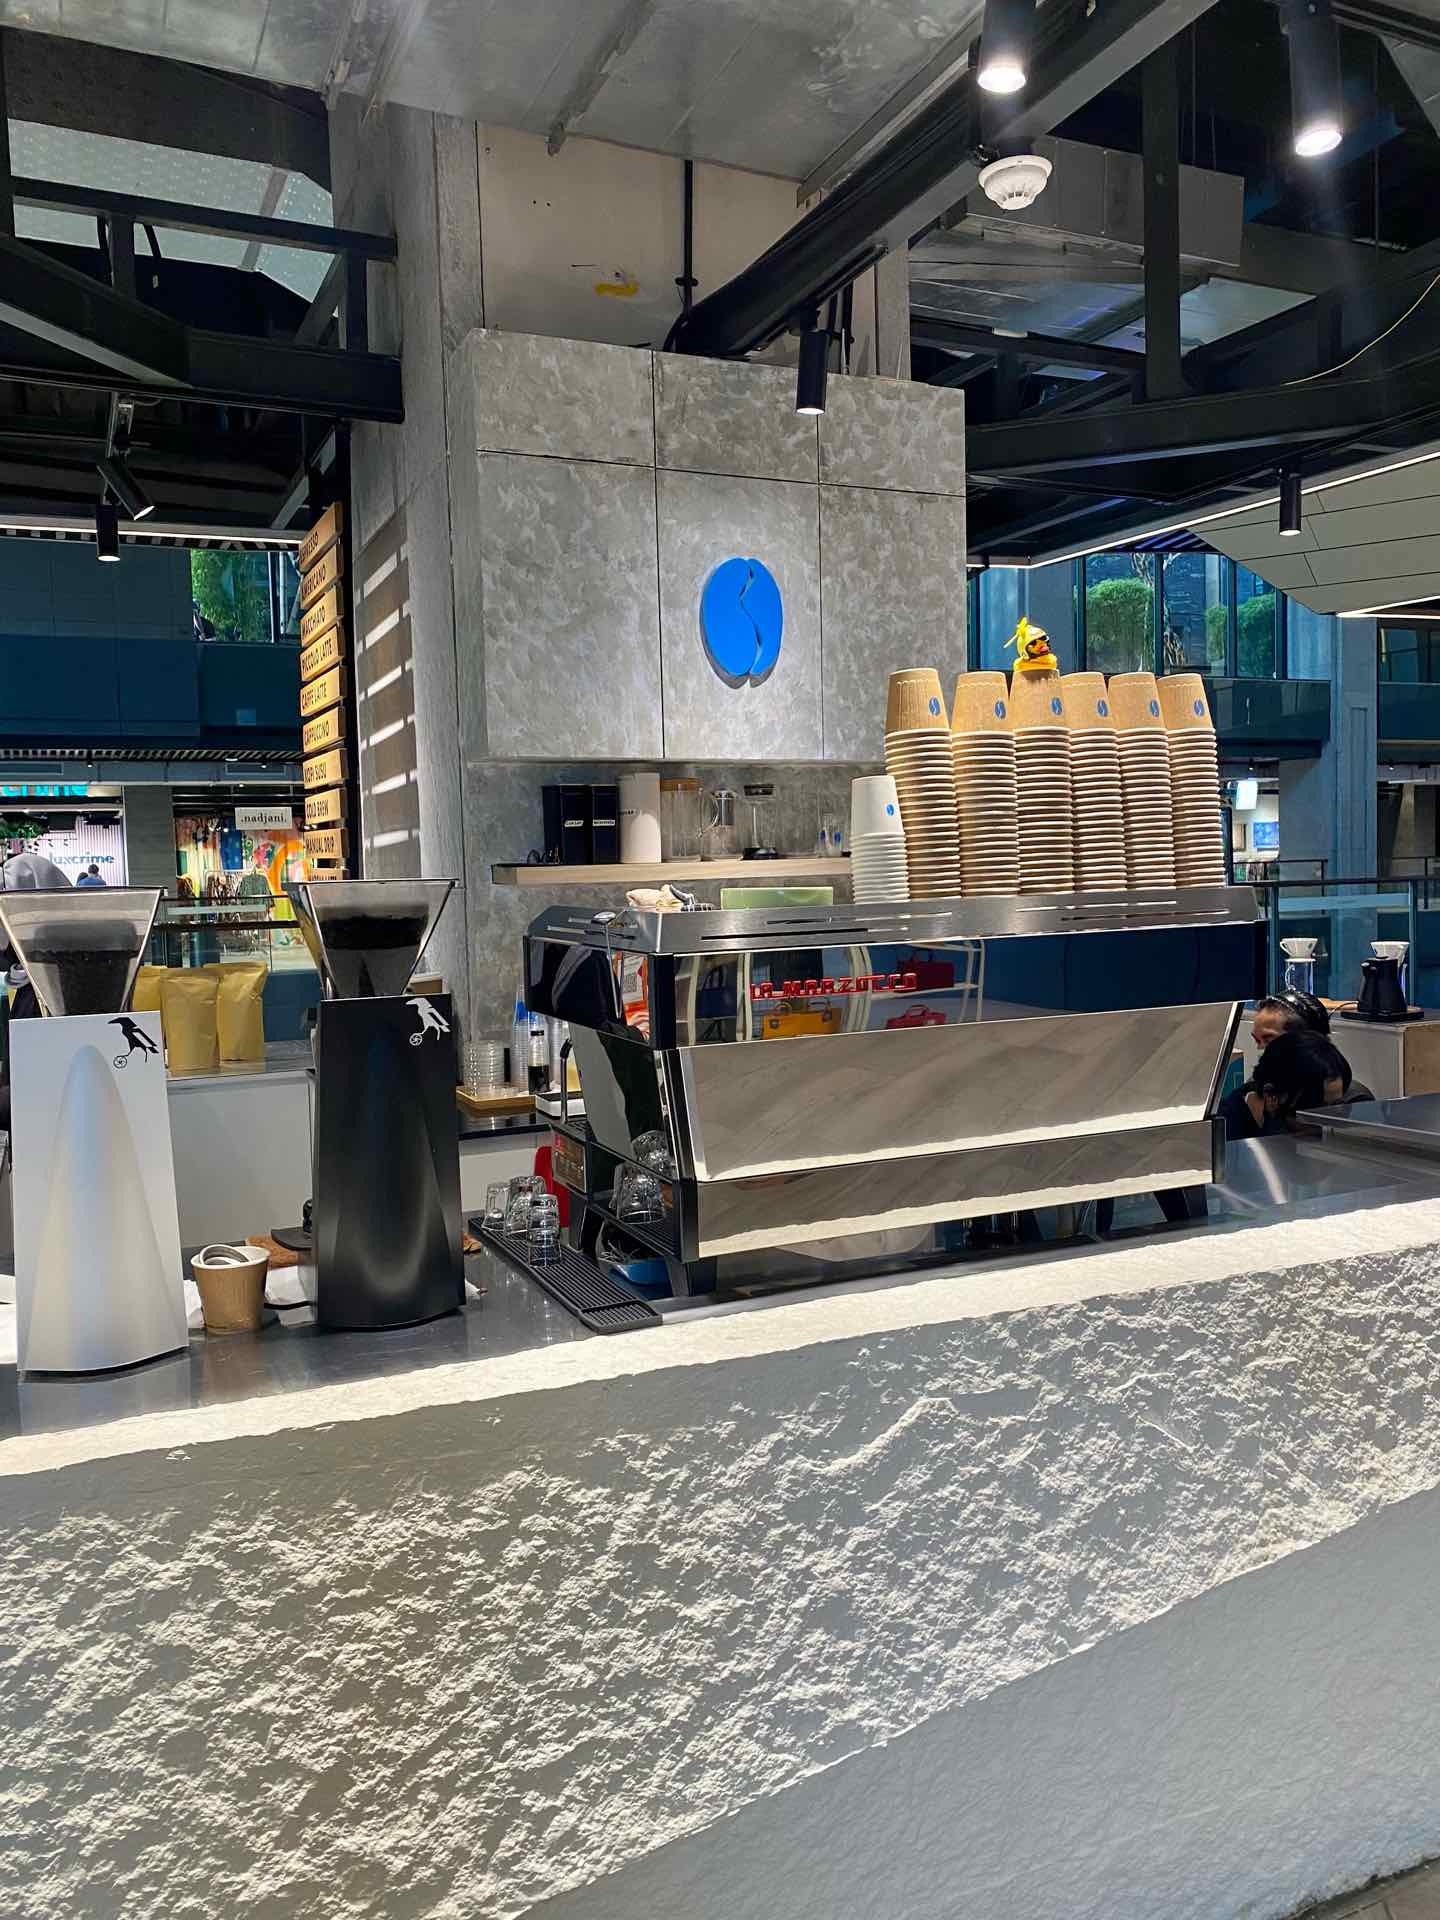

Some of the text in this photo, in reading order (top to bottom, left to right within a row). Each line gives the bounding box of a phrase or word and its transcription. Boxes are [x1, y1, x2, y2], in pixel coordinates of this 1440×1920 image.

[320, 638, 332, 661] LATTE
[317, 800, 329, 817] BREW
[324, 836, 335, 853] DRIP
